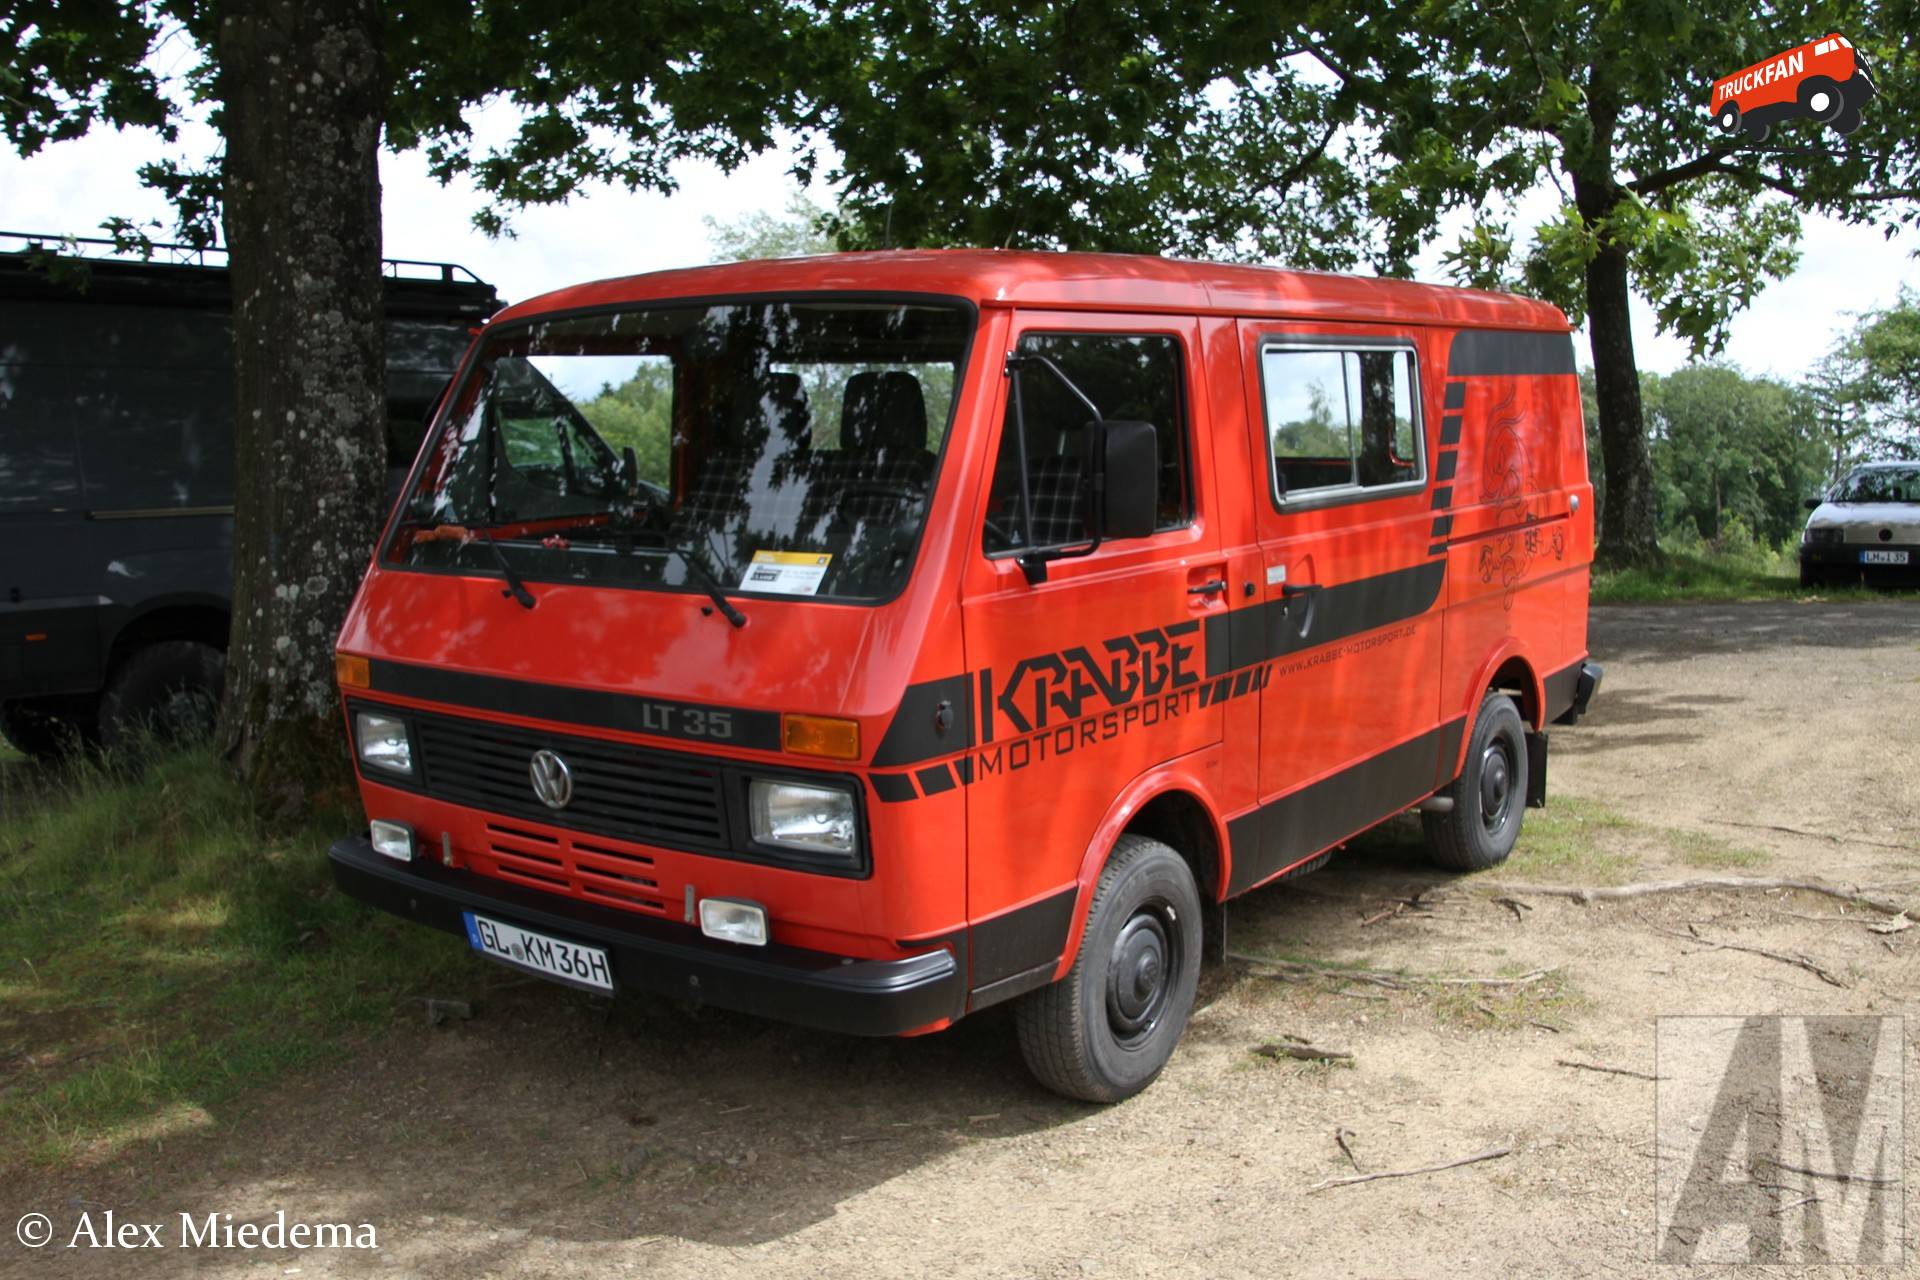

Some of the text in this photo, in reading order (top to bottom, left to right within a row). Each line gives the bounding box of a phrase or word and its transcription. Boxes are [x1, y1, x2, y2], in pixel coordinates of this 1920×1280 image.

[642, 703, 732, 738] LT 35
[979, 618, 1200, 745] KRABBE
[979, 687, 1196, 781] MOTORSPORT
